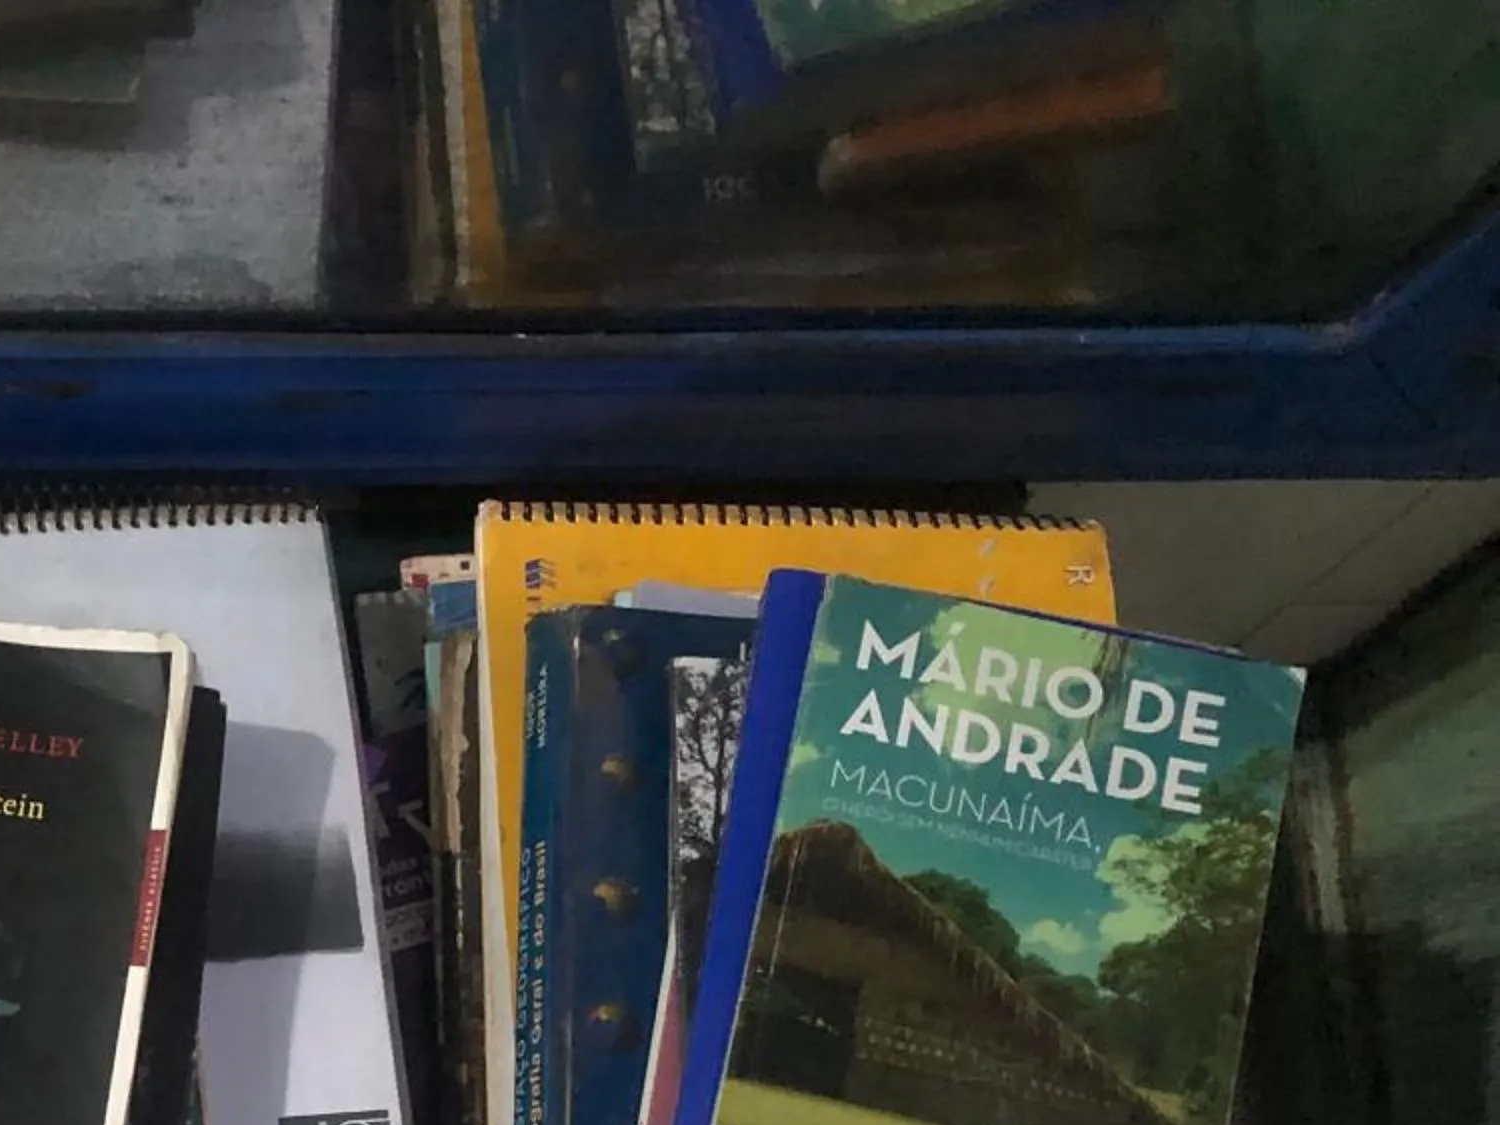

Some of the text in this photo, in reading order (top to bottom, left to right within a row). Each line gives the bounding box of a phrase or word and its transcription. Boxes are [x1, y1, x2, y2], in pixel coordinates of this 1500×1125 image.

[856, 619, 1227, 747] MÁRIO DE
[840, 688, 1208, 815] ANDRADE
[533, 841, 547, 907] Brasil
[533, 913, 546, 948] do
[531, 978, 543, 1044] Geral
